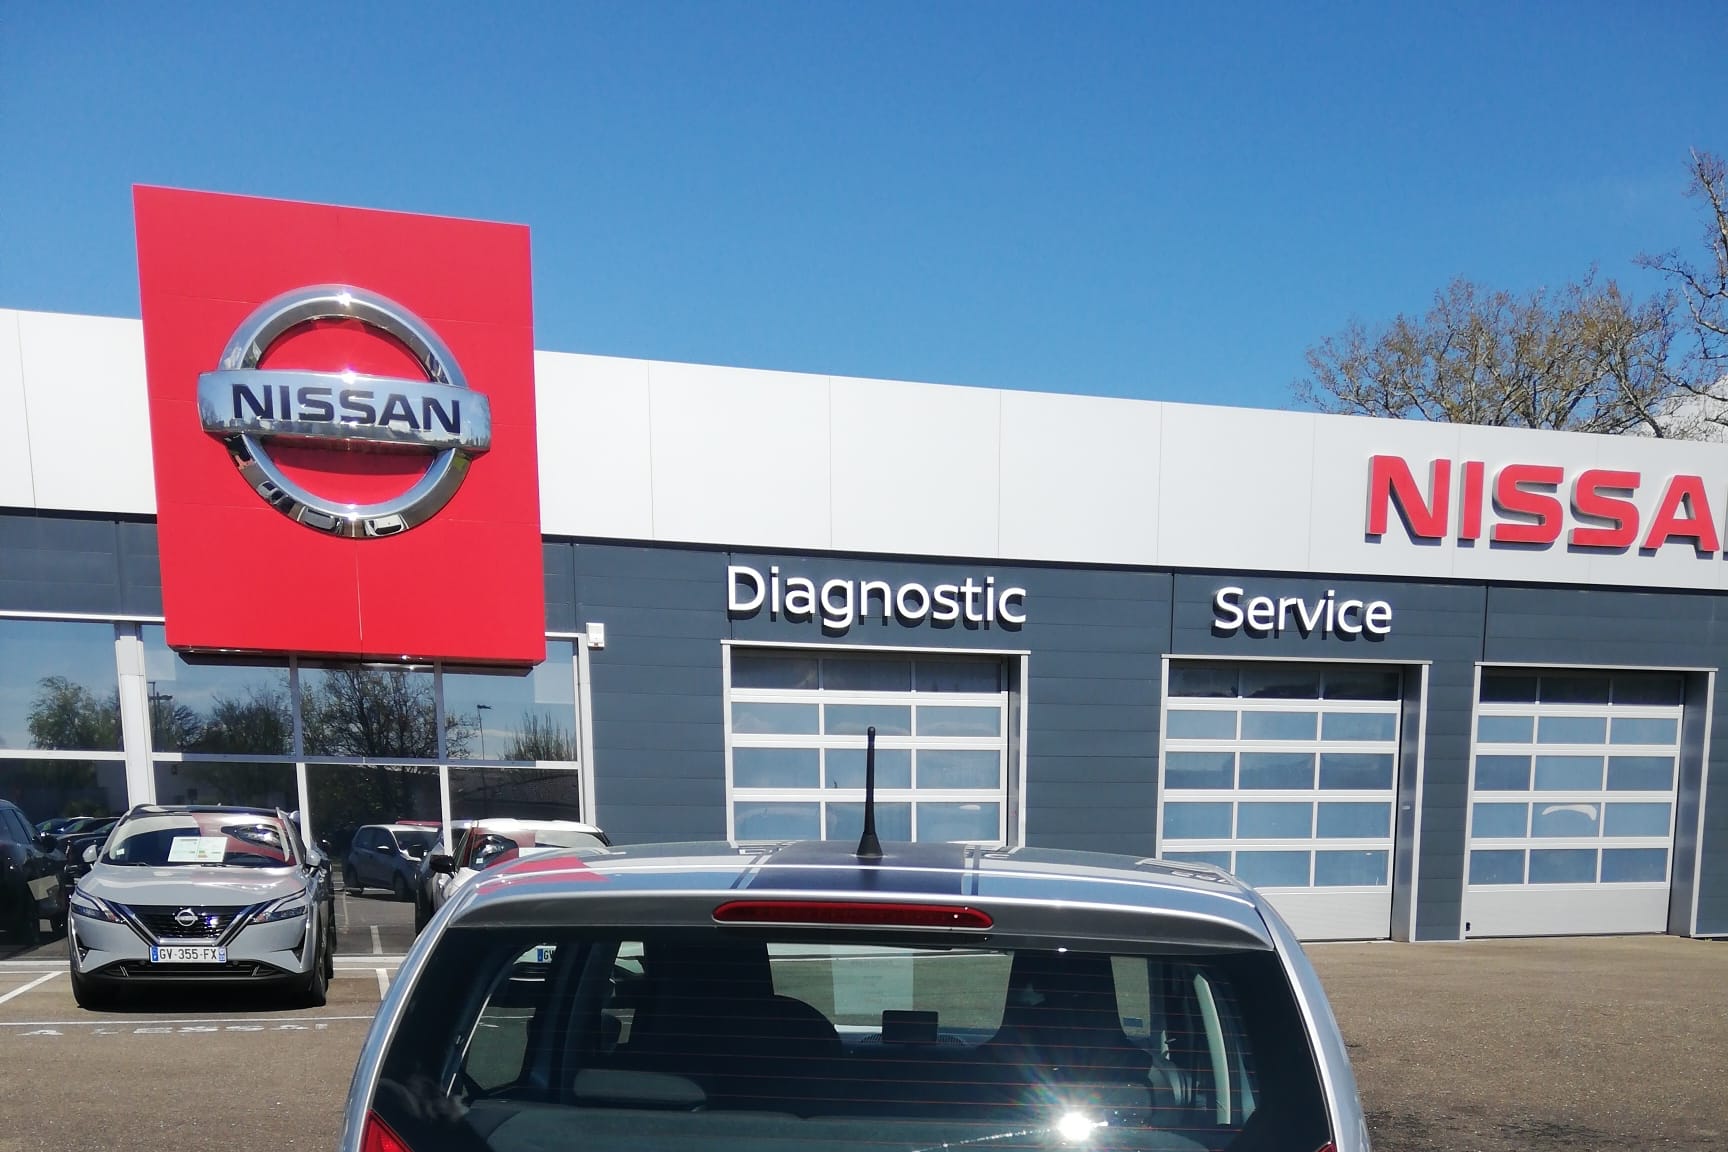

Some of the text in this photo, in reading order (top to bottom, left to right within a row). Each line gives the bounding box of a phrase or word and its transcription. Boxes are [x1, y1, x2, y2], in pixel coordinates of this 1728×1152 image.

[232, 384, 461, 434] NISSAN
[1366, 454, 1728, 558] NISSA
[727, 565, 1027, 629] Diagnostic
[1213, 586, 1393, 635] Service
